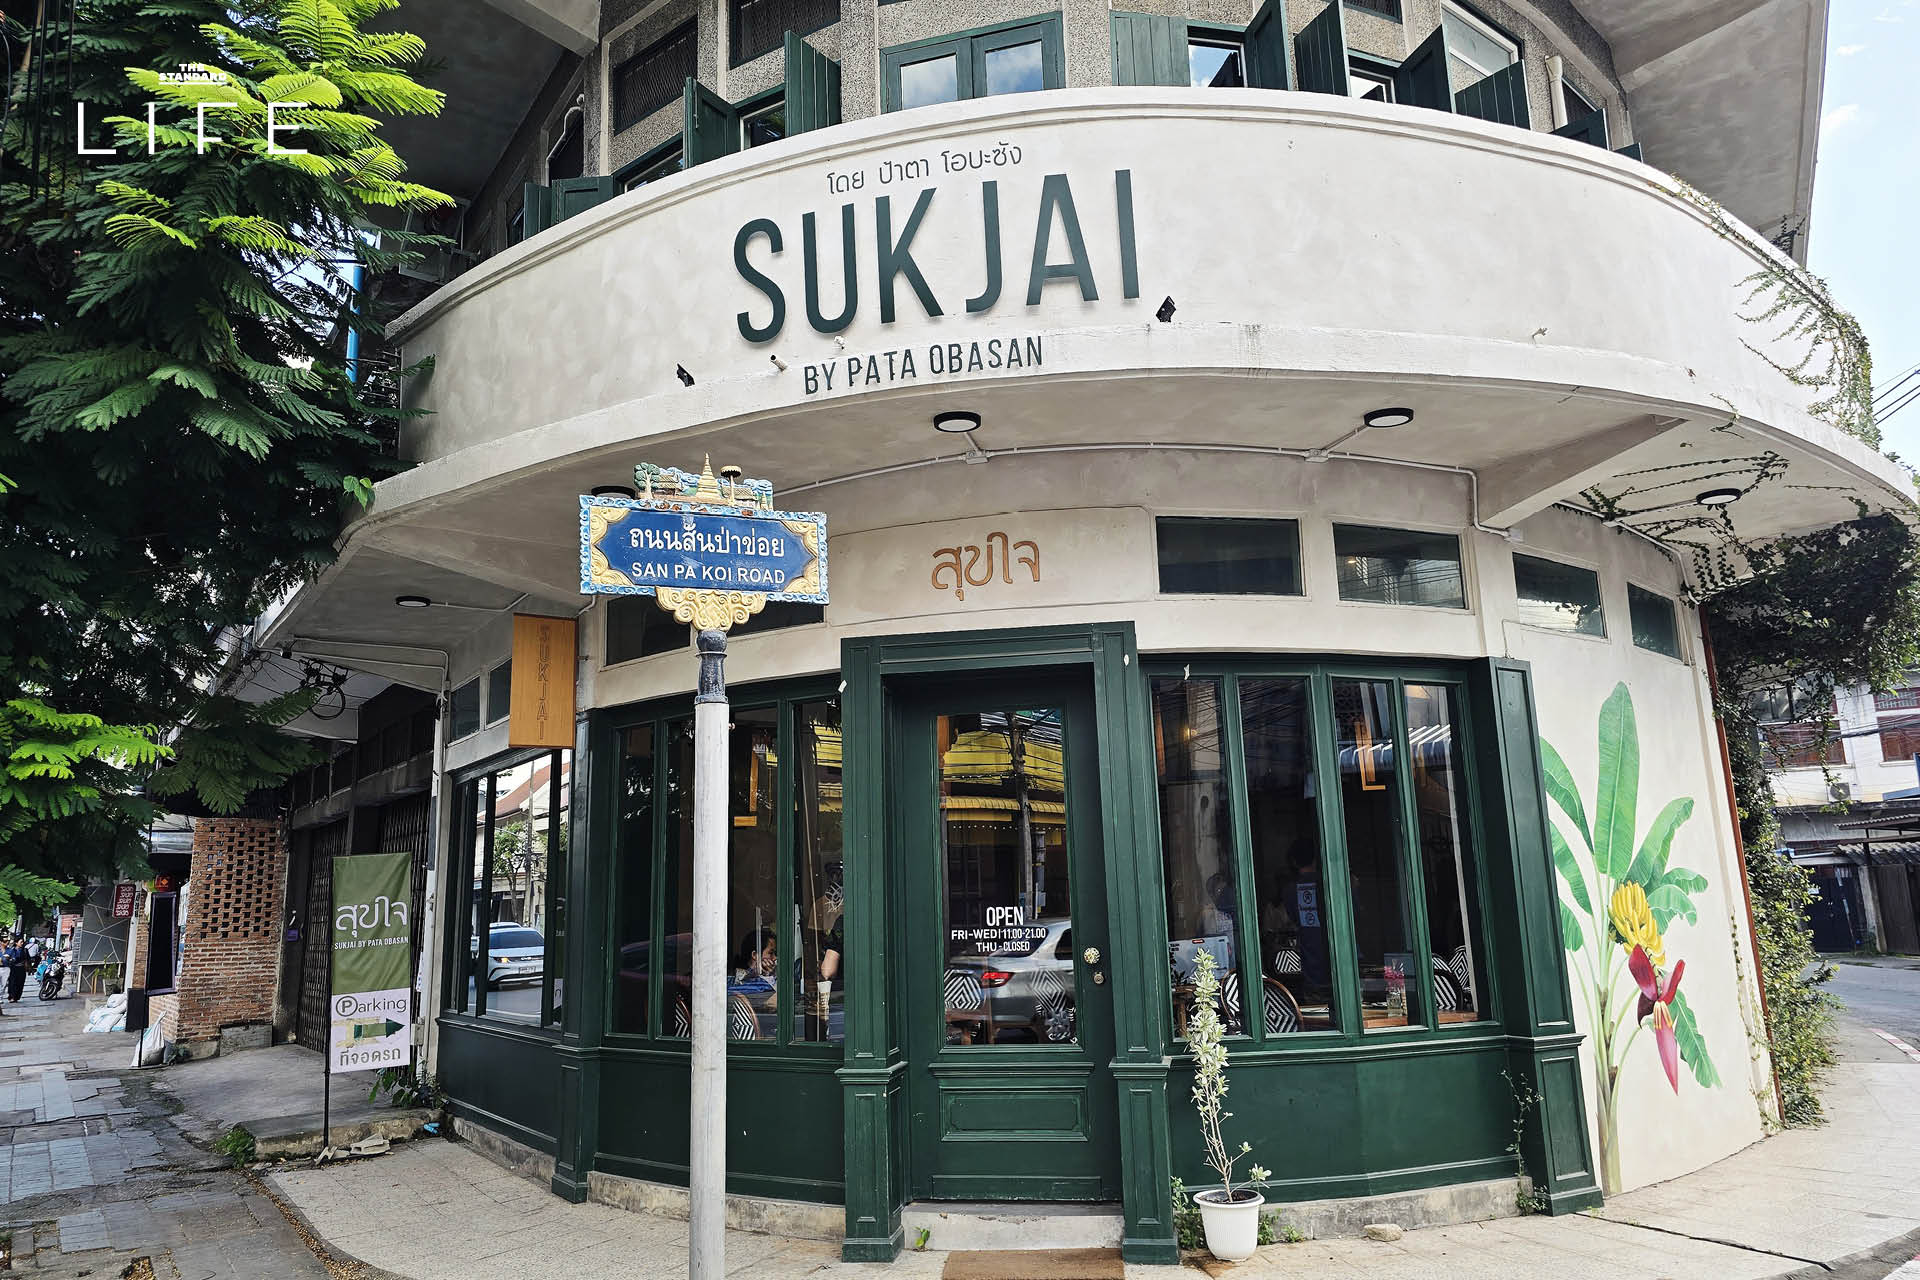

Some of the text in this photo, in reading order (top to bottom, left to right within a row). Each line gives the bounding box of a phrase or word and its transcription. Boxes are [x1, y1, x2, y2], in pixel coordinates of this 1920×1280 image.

[827, 141, 1023, 194] โดย ป้าตา โอบะซัง
[733, 169, 1140, 344] SUKJAI
[804, 335, 1043, 395] BY PATA OBASAN
[629, 522, 785, 558] ถนนสันป่าข่อย
[631, 562, 785, 584] SAN PA KOI ROAD
[931, 531, 1041, 602] สุขใจ
[335, 895, 408, 938] สุขใจ
[986, 906, 1024, 926] OPEN
[334, 935, 409, 950] SUKJAI BY PATA OBASAN
[951, 929, 997, 940] FRI-WED
[976, 942, 997, 953] THU
[1003, 941, 1030, 951] CLOSED
[337, 996, 407, 1015] Parking
